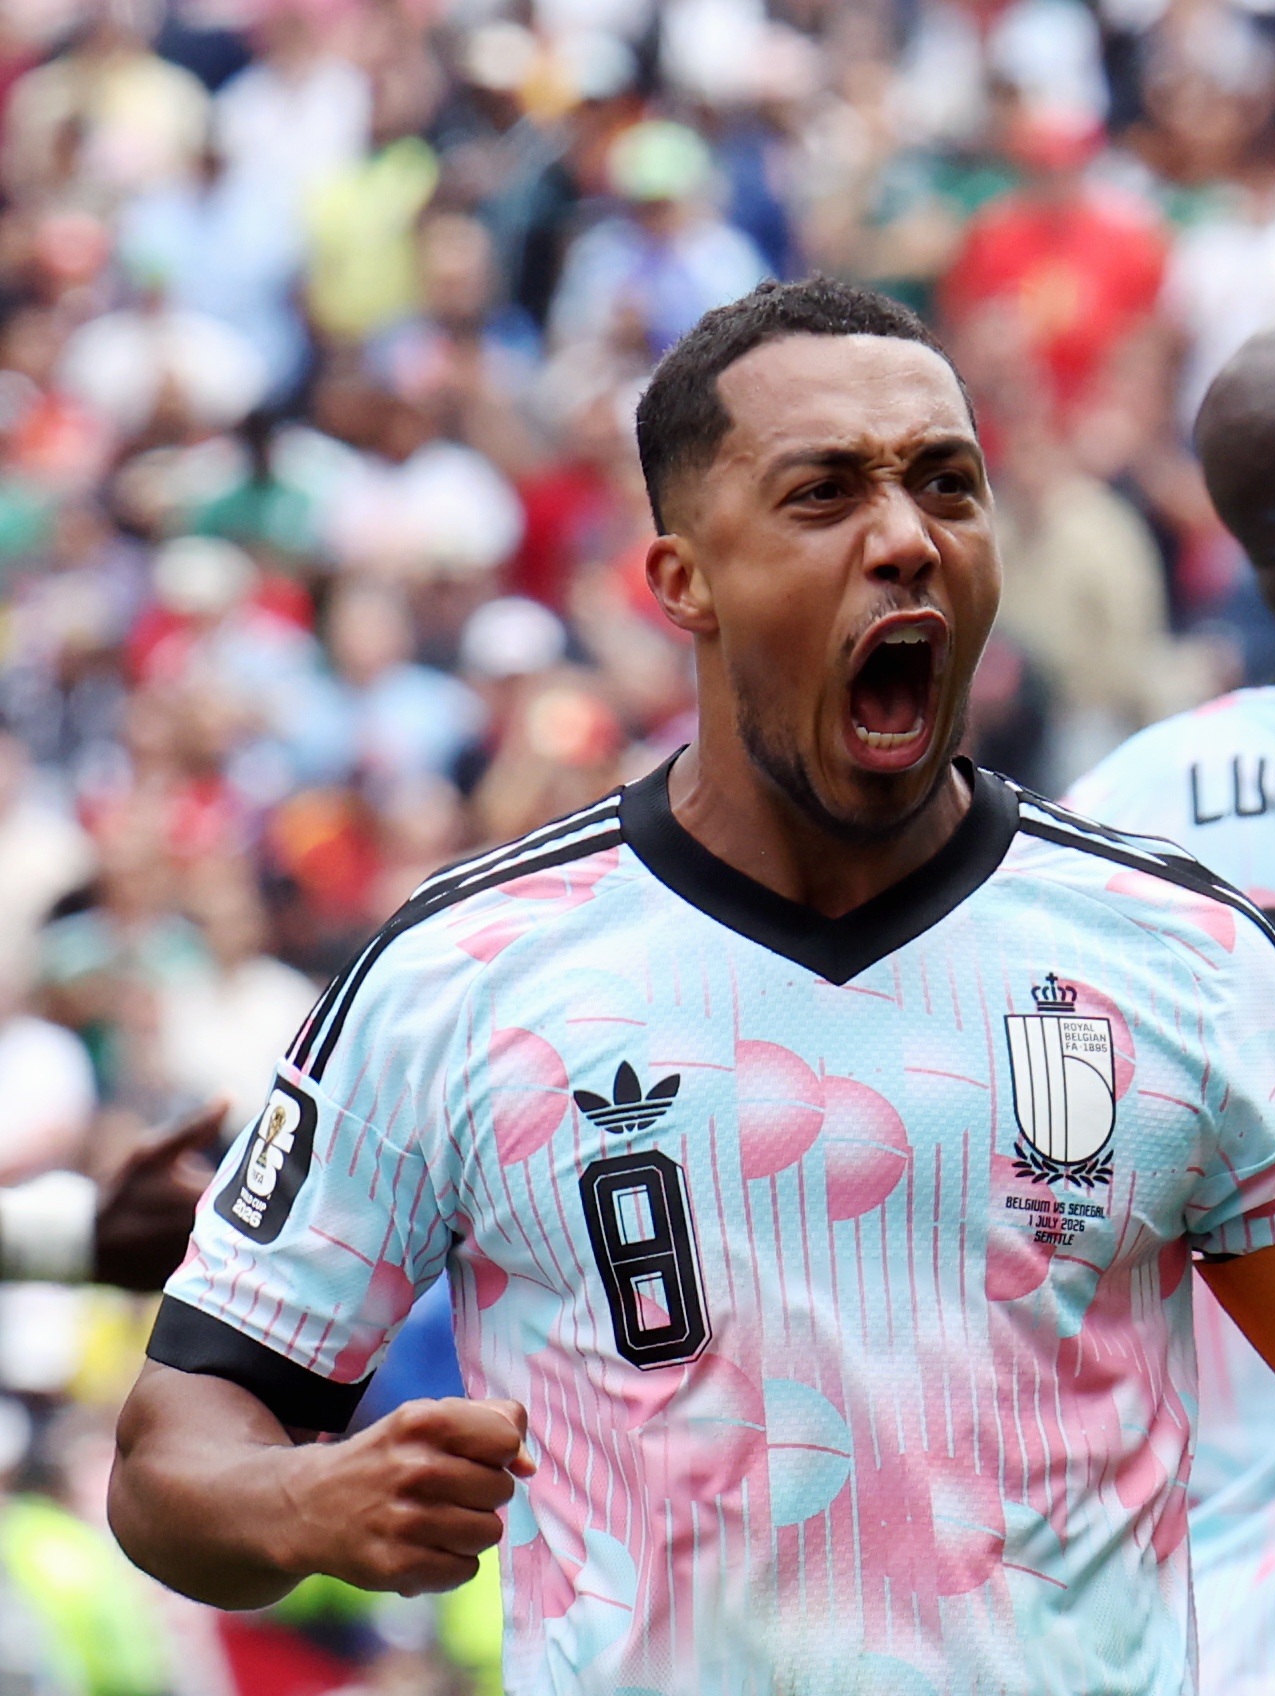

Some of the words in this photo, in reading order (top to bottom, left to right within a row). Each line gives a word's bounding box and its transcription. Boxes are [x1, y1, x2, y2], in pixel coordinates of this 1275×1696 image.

[1063, 1022, 1095, 1032] ROYAL
[1065, 1032, 1107, 1042] BELGIAN
[232, 1198, 263, 1228] 2026
[1005, 1196, 1051, 1213] BELGIUM
[1053, 1202, 1066, 1215] VS
[1068, 1203, 1106, 1219] SENEGAL
[1028, 1213, 1034, 1227] 1
[1035, 1215, 1059, 1229] JULY
[1060, 1217, 1086, 1232] 2026
[1033, 1230, 1075, 1246] SEATTLE
[579, 1150, 712, 1371] 8
